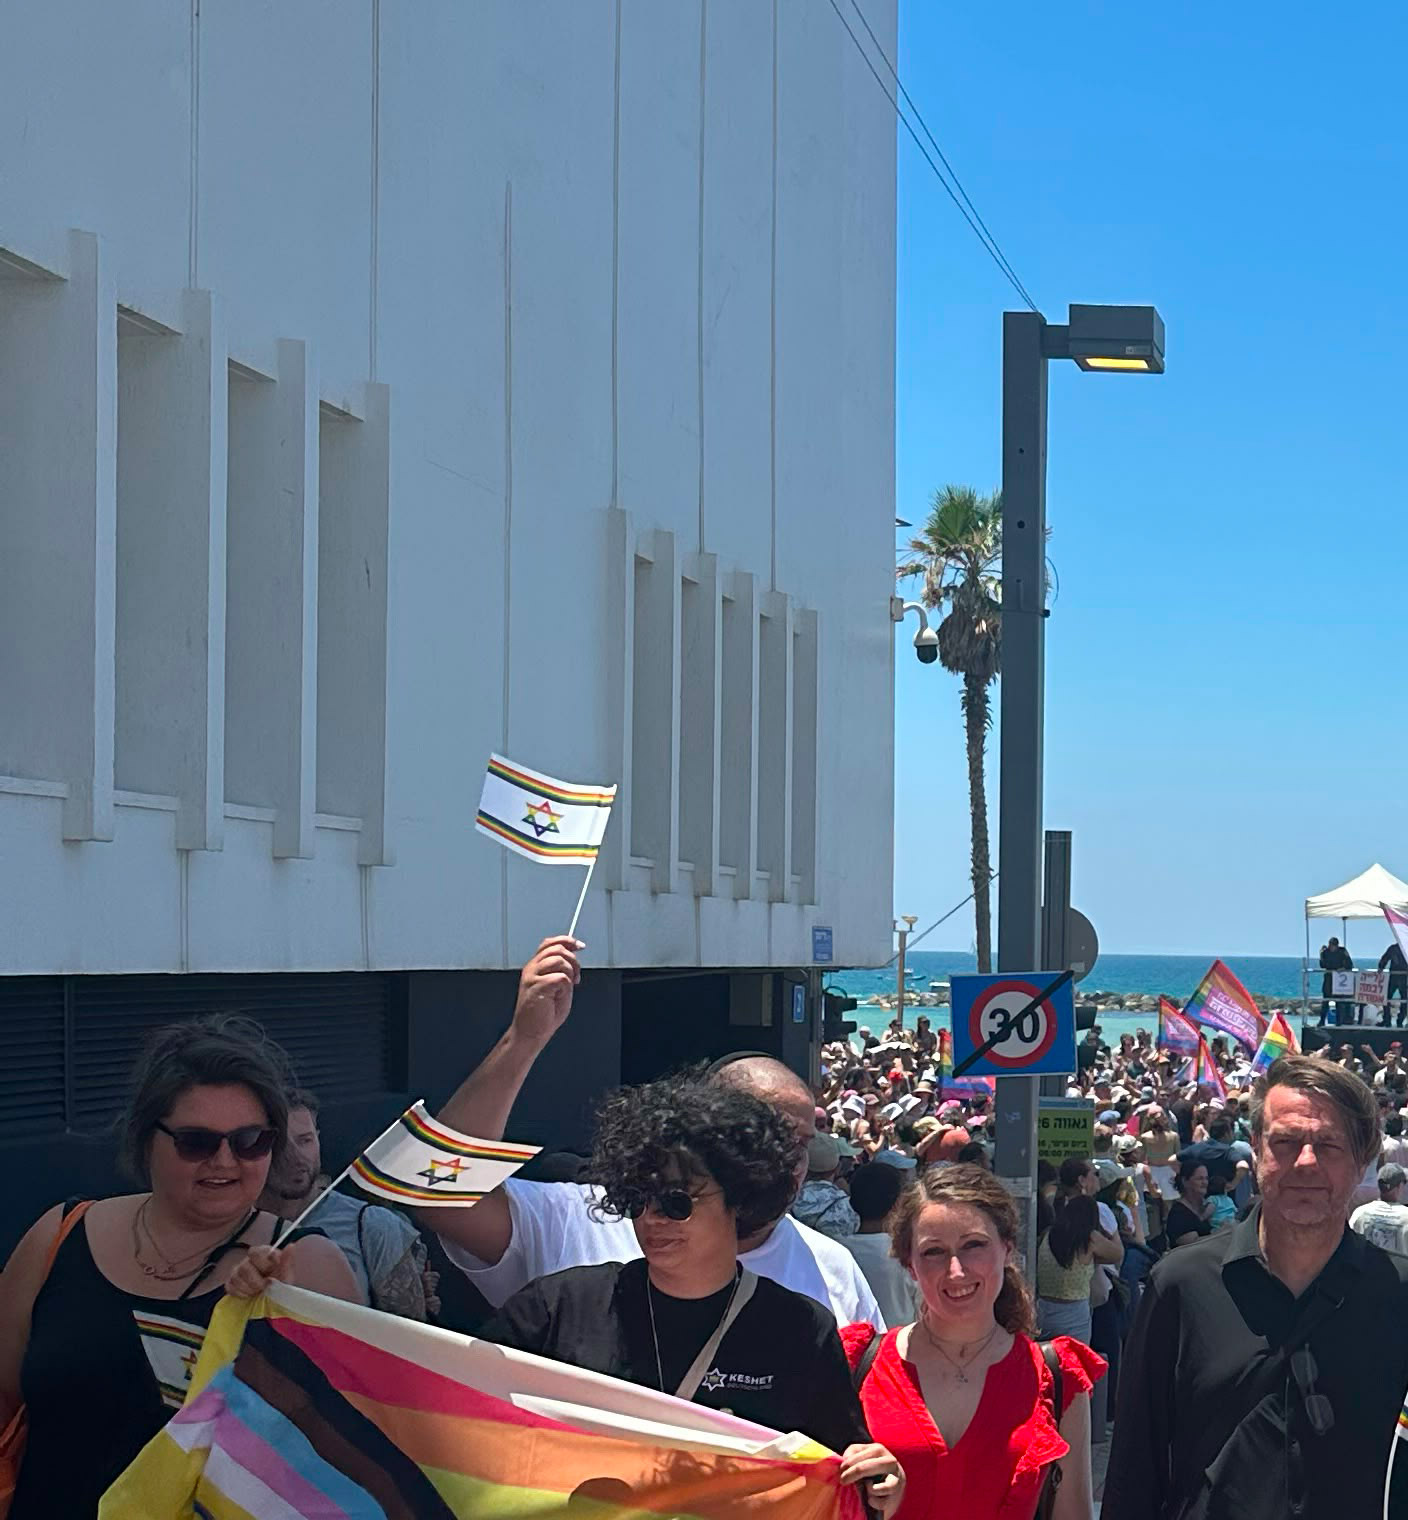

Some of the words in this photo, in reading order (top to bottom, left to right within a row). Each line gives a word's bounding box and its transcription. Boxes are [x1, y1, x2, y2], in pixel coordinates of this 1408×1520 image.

[1338, 973, 1348, 987] 2
[988, 1008, 1040, 1043] 30
[1053, 1117, 1088, 1129] גאווה
[729, 1373, 774, 1385] KESHET
